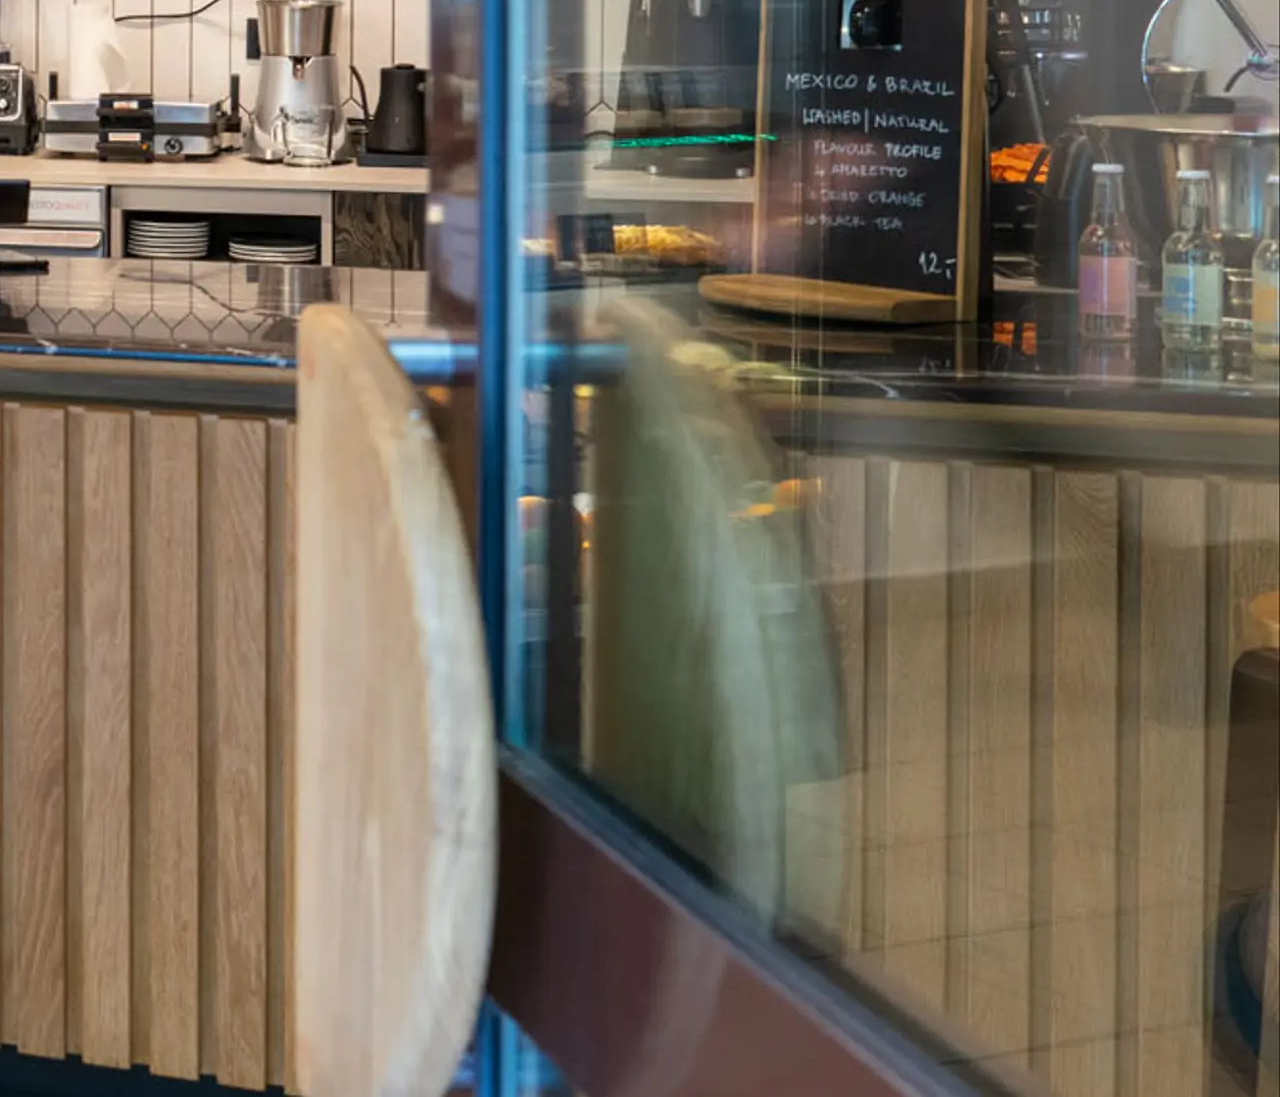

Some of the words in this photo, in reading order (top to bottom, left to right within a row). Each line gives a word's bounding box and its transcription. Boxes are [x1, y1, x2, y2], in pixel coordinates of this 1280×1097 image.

[786, 73, 859, 91] MEXICO
[866, 75, 878, 92] &
[885, 76, 954, 96] BRAZIL
[802, 107, 861, 125] WASHED
[874, 113, 949, 133] NATURAL
[814, 139, 877, 157] FLAVOUR
[884, 142, 942, 160] PROFILE
[831, 164, 908, 178] AMARETTO
[868, 191, 927, 206] ORANGE
[874, 217, 904, 230] TEA
